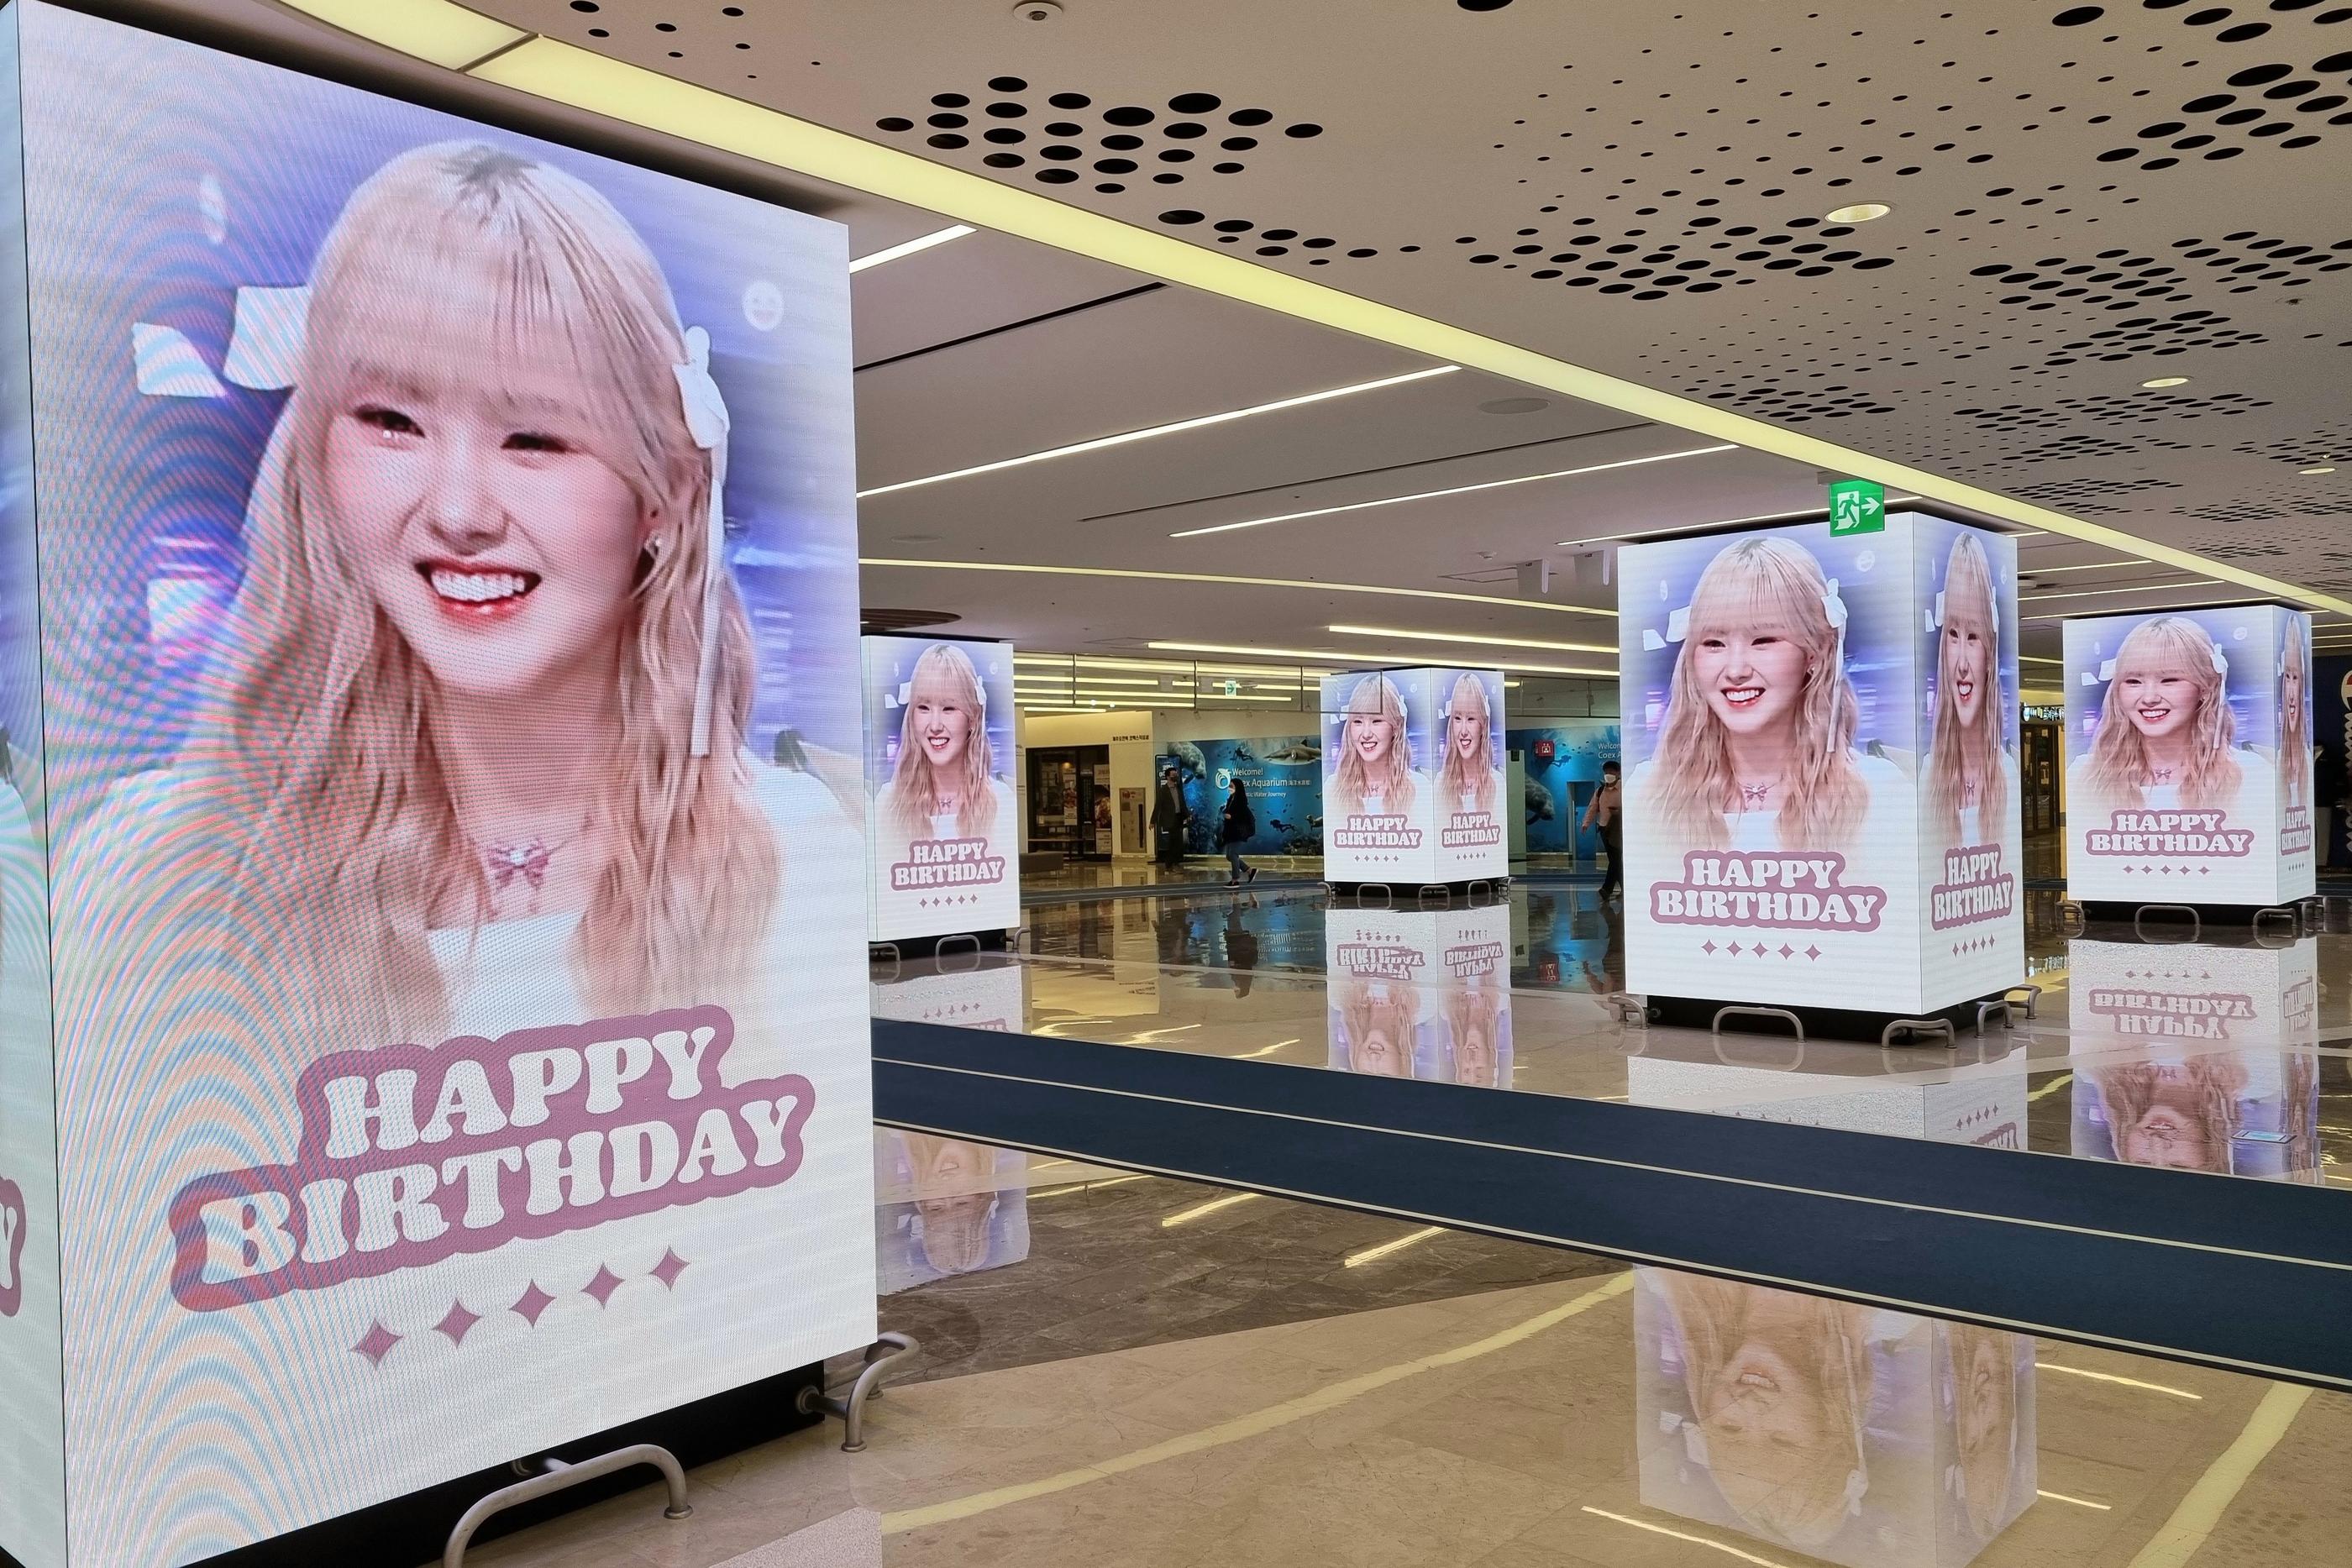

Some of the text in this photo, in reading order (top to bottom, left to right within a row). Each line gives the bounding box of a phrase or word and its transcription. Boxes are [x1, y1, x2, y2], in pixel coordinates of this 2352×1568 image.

[1231, 768, 1263, 776] Welcome!
[1252, 778, 1288, 789] Aquarium
[1350, 817, 1404, 831] HAPPY
[1452, 815, 1490, 829] HAPPY
[2116, 814, 2220, 831] HAPPY
[2286, 810, 2306, 829] HAPPY
[1336, 832, 1420, 846] BIRTHDAY
[1443, 828, 1499, 845] BIRTHDAY
[2091, 834, 2249, 852] BIRTHDAY
[2281, 828, 2311, 851] BIRTHDAY
[914, 843, 984, 863] HAPPY
[895, 861, 1001, 885] BIRTHDAY
[1692, 857, 1837, 889] HAPPY
[1946, 851, 2000, 886] HAPPY
[1656, 889, 1878, 924] BIRTHDAY
[1935, 880, 2012, 922] BIRTHDAY
[324, 1025, 716, 1159] HAPPY
[199, 1096, 798, 1285] BIRTHDAY
